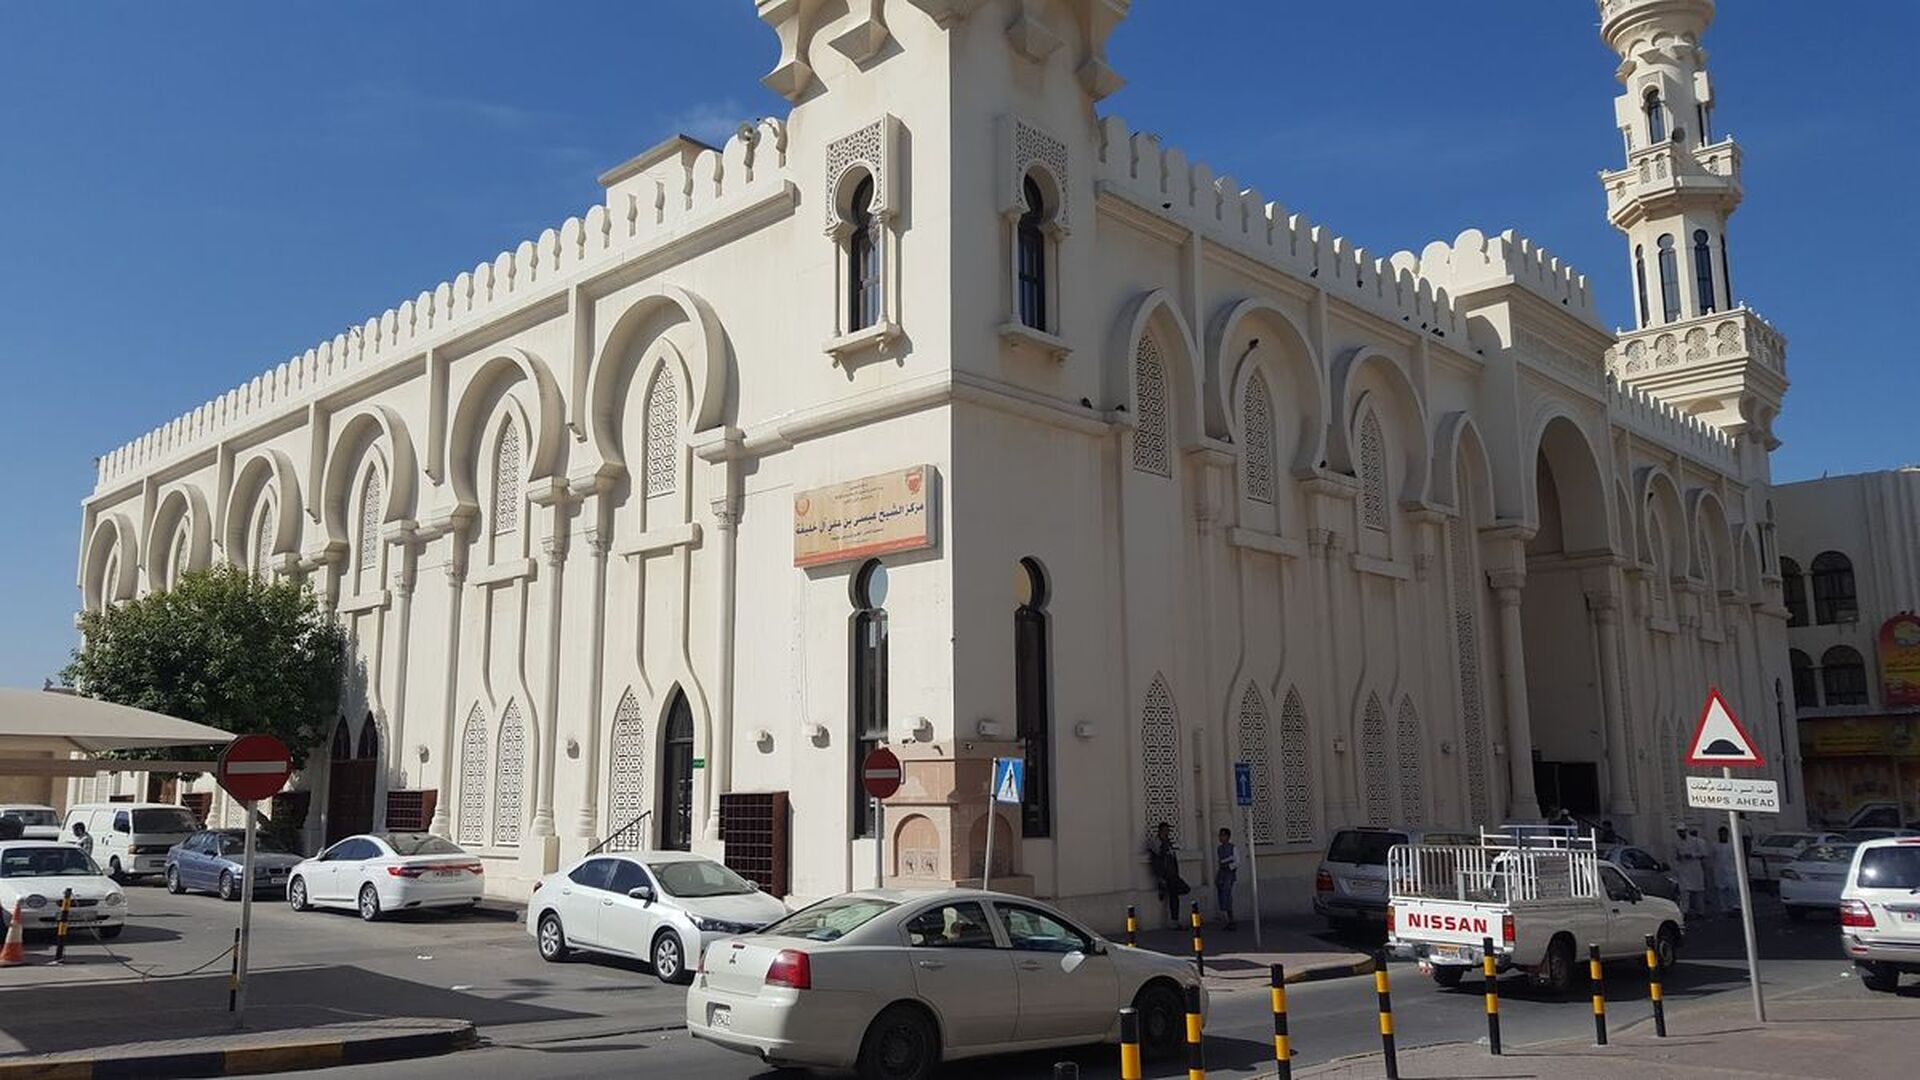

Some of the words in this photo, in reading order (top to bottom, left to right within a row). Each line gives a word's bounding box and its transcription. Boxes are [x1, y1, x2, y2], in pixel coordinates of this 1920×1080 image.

[878, 503, 904, 522] الشيخ
[904, 502, 924, 516] مركز
[795, 522, 818, 536] خليفة
[1691, 795, 1731, 806] HUMPS
[1736, 797, 1776, 808] AHEAD
[1408, 913, 1488, 934] NISSAN
